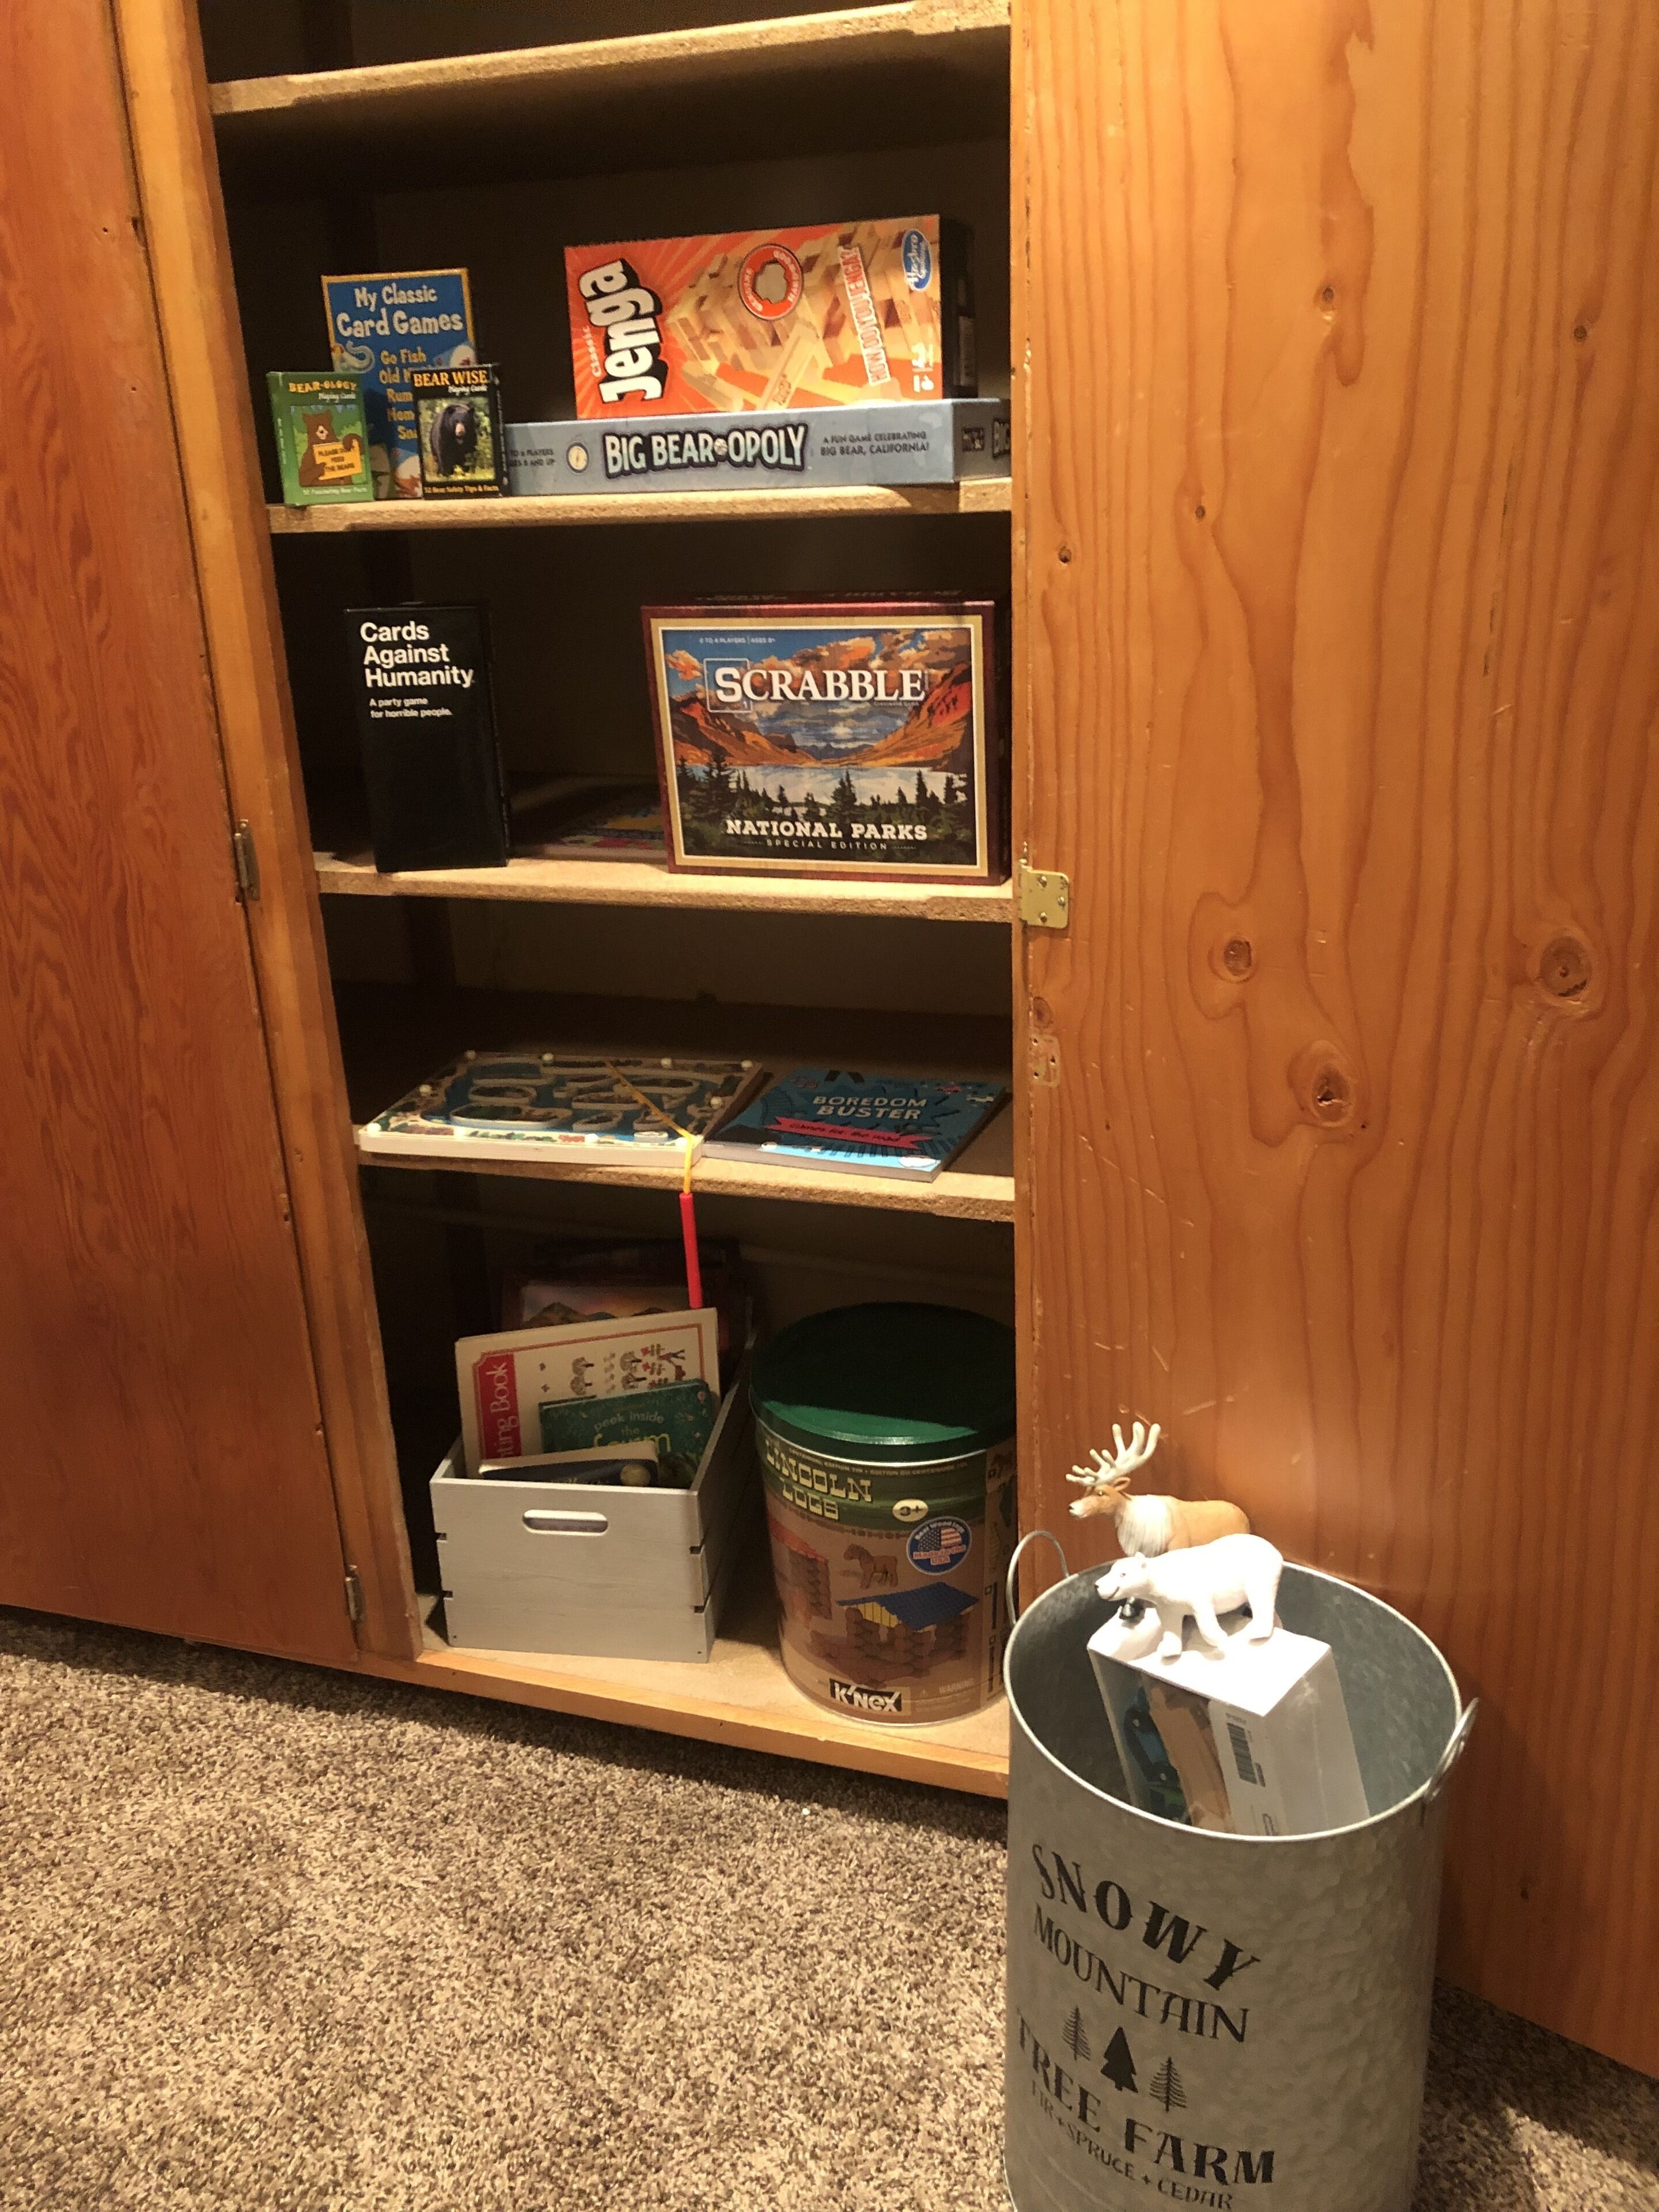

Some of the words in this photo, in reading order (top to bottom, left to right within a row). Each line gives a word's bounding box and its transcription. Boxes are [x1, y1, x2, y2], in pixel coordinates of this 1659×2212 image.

[354, 287, 377, 312] My
[382, 282, 438, 305] Classic
[336, 309, 390, 338] Card
[393, 310, 464, 335] Games
[578, 259, 664, 403] Jenga
[381, 350, 397, 365] Go
[400, 346, 427, 363] Fish
[581, 325, 602, 377] Classic
[289, 380, 357, 393] BEAR-OLOGY
[380, 368, 400, 384] Old
[414, 372, 450, 388] BEAR
[452, 370, 488, 385] WISE
[605, 433, 646, 474] BIG
[652, 430, 714, 468] BEAR
[728, 426, 805, 467] OPOLY
[820, 446, 836, 456] BIG
[839, 445, 866, 456] BEAR,
[869, 442, 929, 454] CALIFORNIA!
[831, 435, 846, 444] FUN
[849, 433, 872, 442] GAME
[360, 620, 430, 642] Cards
[363, 643, 450, 669] Against
[365, 665, 474, 688] Humanity
[714, 666, 926, 703] SCRABBLE
[369, 698, 377, 707] A
[378, 698, 402, 708] party
[403, 698, 428, 707] game
[371, 710, 383, 718] for
[385, 709, 419, 718] horrible
[726, 820, 842, 838] NATIONAL
[851, 823, 928, 840] PARKS
[766, 839, 823, 850] SPECIAL
[831, 842, 888, 851] EDITION
[812, 1096, 927, 1108] BOREDOM
[816, 1105, 922, 1120] BUSTER
[485, 1362, 510, 1413] Book
[593, 1413, 626, 1433] peek
[630, 1410, 665, 1425] inside
[621, 1426, 640, 1435] the
[765, 1440, 873, 1503] LINCOLN
[781, 1479, 839, 1521] LOGS
[1032, 1844, 1260, 1991] SNOWY
[1034, 1902, 1250, 2043] MOUNTAIN
[1017, 2007, 1101, 2133] TREE
[1124, 2118, 1275, 2186] FARM
[1067, 2123, 1136, 2181] SPRUCE
[1157, 2177, 1234, 2210] CEDAR
